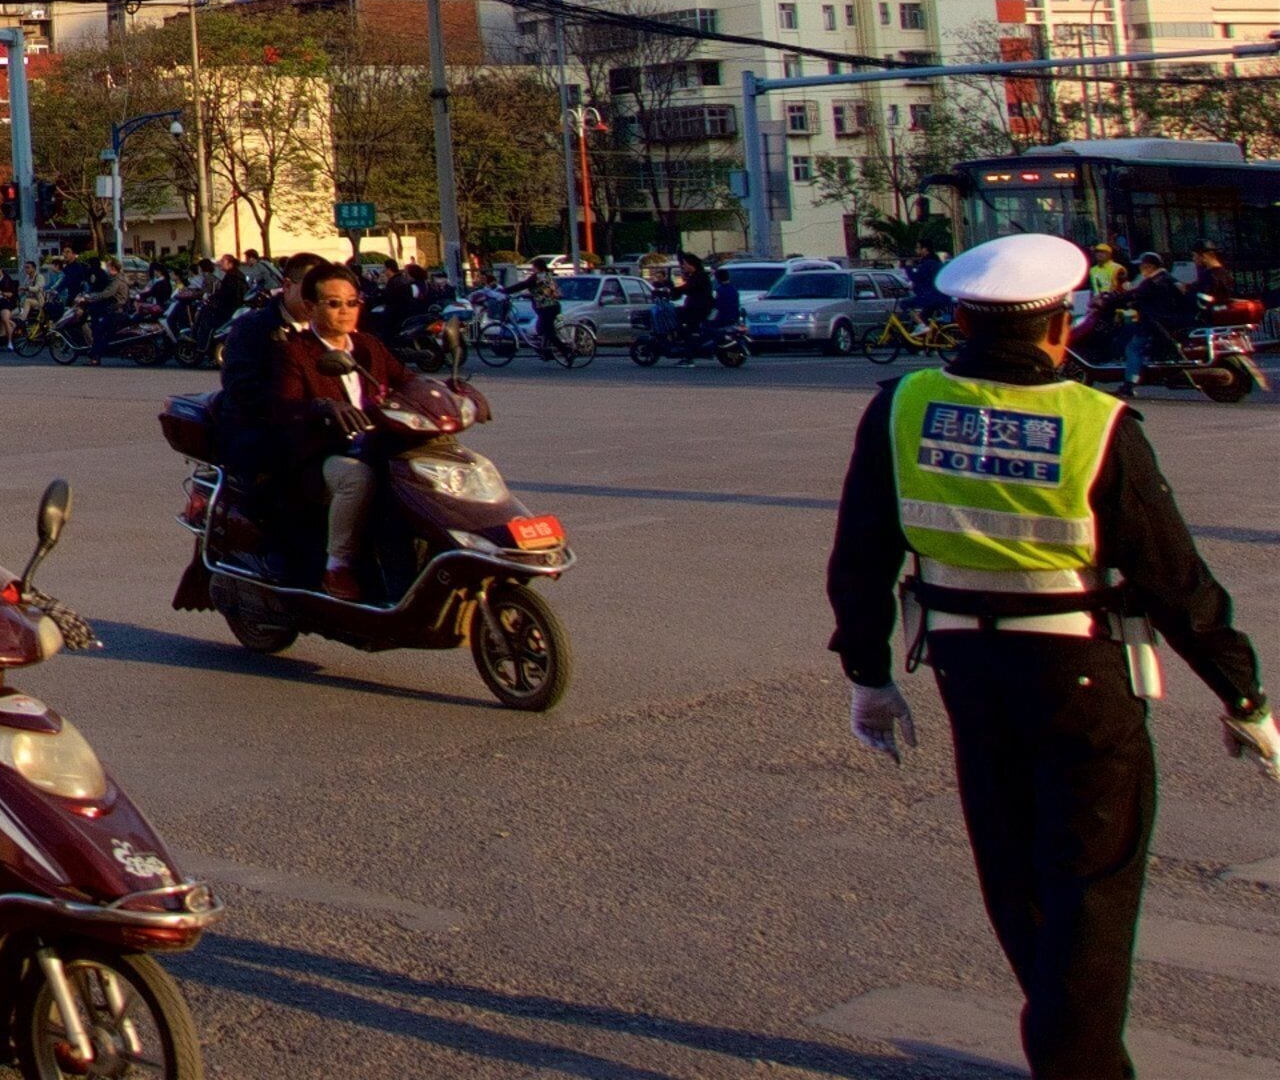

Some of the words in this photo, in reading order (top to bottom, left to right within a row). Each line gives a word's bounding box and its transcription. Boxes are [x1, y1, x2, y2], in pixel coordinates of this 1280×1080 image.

[931, 407, 1057, 450] 昆明交警
[930, 448, 1048, 480] POLICE
